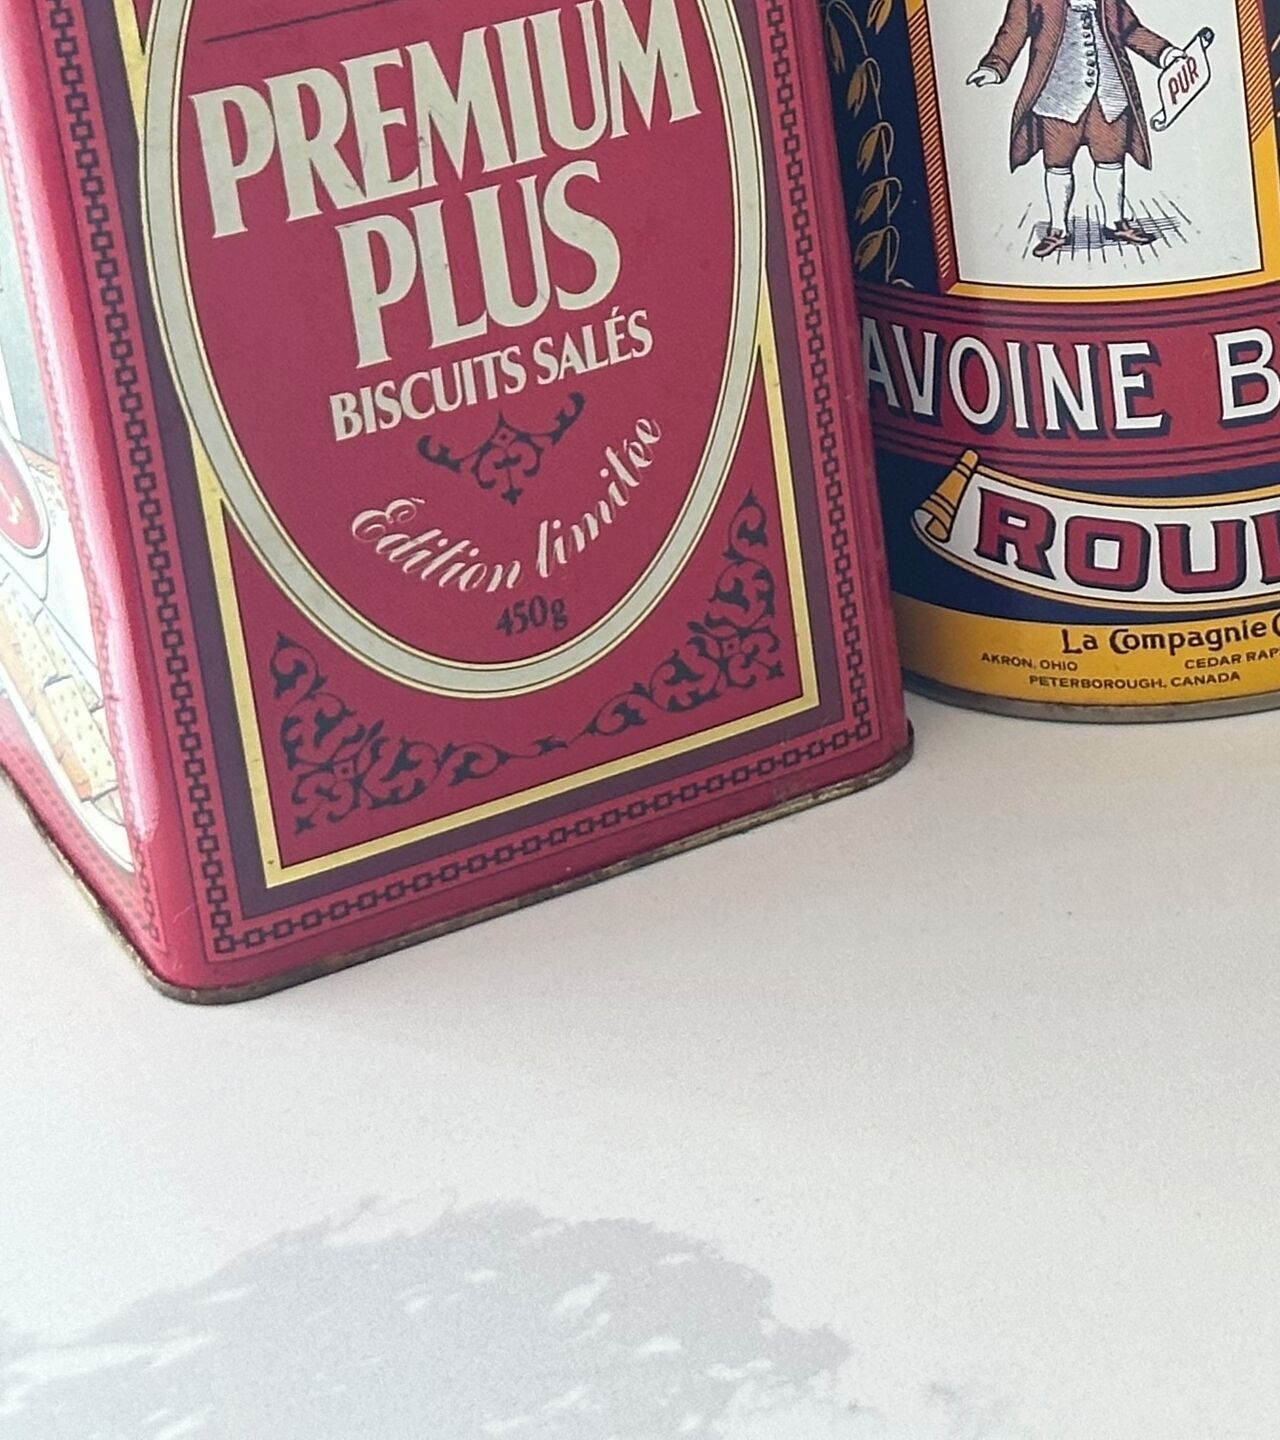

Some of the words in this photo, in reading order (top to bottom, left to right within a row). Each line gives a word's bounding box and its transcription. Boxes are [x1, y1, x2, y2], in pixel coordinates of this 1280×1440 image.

[1168, 56, 1199, 105] PUR
[335, 160, 621, 369] PLUS
[329, 345, 527, 441] BISCUITS
[533, 306, 654, 386] SALÉS
[862, 316, 1166, 433] AVOINE
[352, 495, 522, 594] Édition
[536, 417, 662, 578] limitée
[495, 594, 569, 637] 450g
[1061, 628, 1098, 654] La
[1109, 620, 1267, 656] Compagnie
[1040, 659, 1078, 672] OHIO
[1170, 671, 1240, 688] CANADA
[1184, 653, 1242, 670] CEDAR
